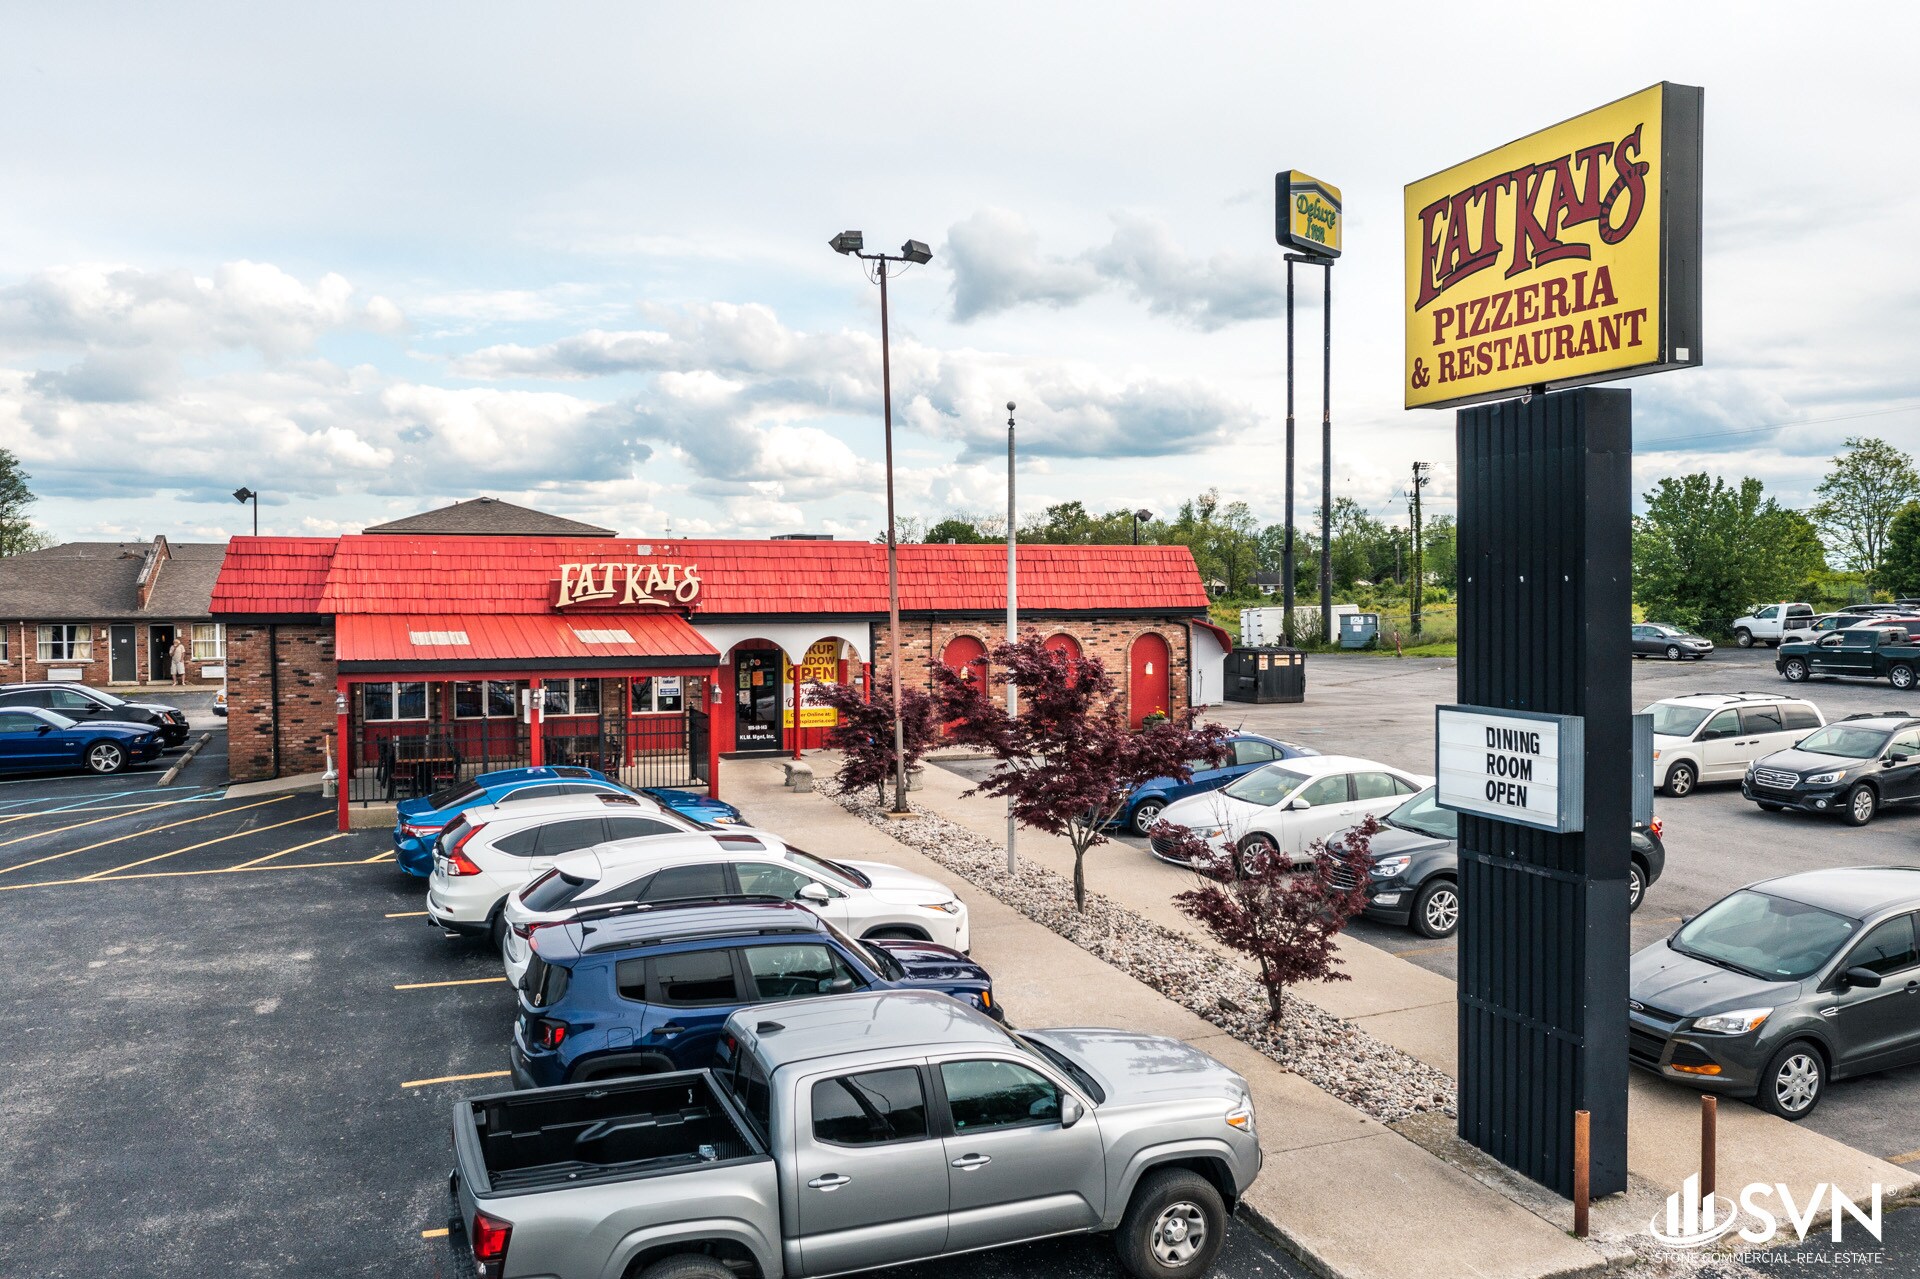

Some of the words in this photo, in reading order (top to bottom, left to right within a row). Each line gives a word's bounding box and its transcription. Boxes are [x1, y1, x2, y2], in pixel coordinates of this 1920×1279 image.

[1296, 194, 1336, 229] Deluxe
[1304, 216, 1325, 243] Inn
[1415, 171, 1512, 312] FAT
[1433, 265, 1618, 346] PIZZERIA
[1411, 357, 1430, 389] &
[1438, 308, 1647, 383] RESTAURANT
[555, 563, 622, 607] FAT
[619, 563, 701, 607] KATS
[1485, 726, 1540, 755] DINING
[1486, 753, 1532, 781] ROOM
[1485, 780, 1527, 808] OPEN
